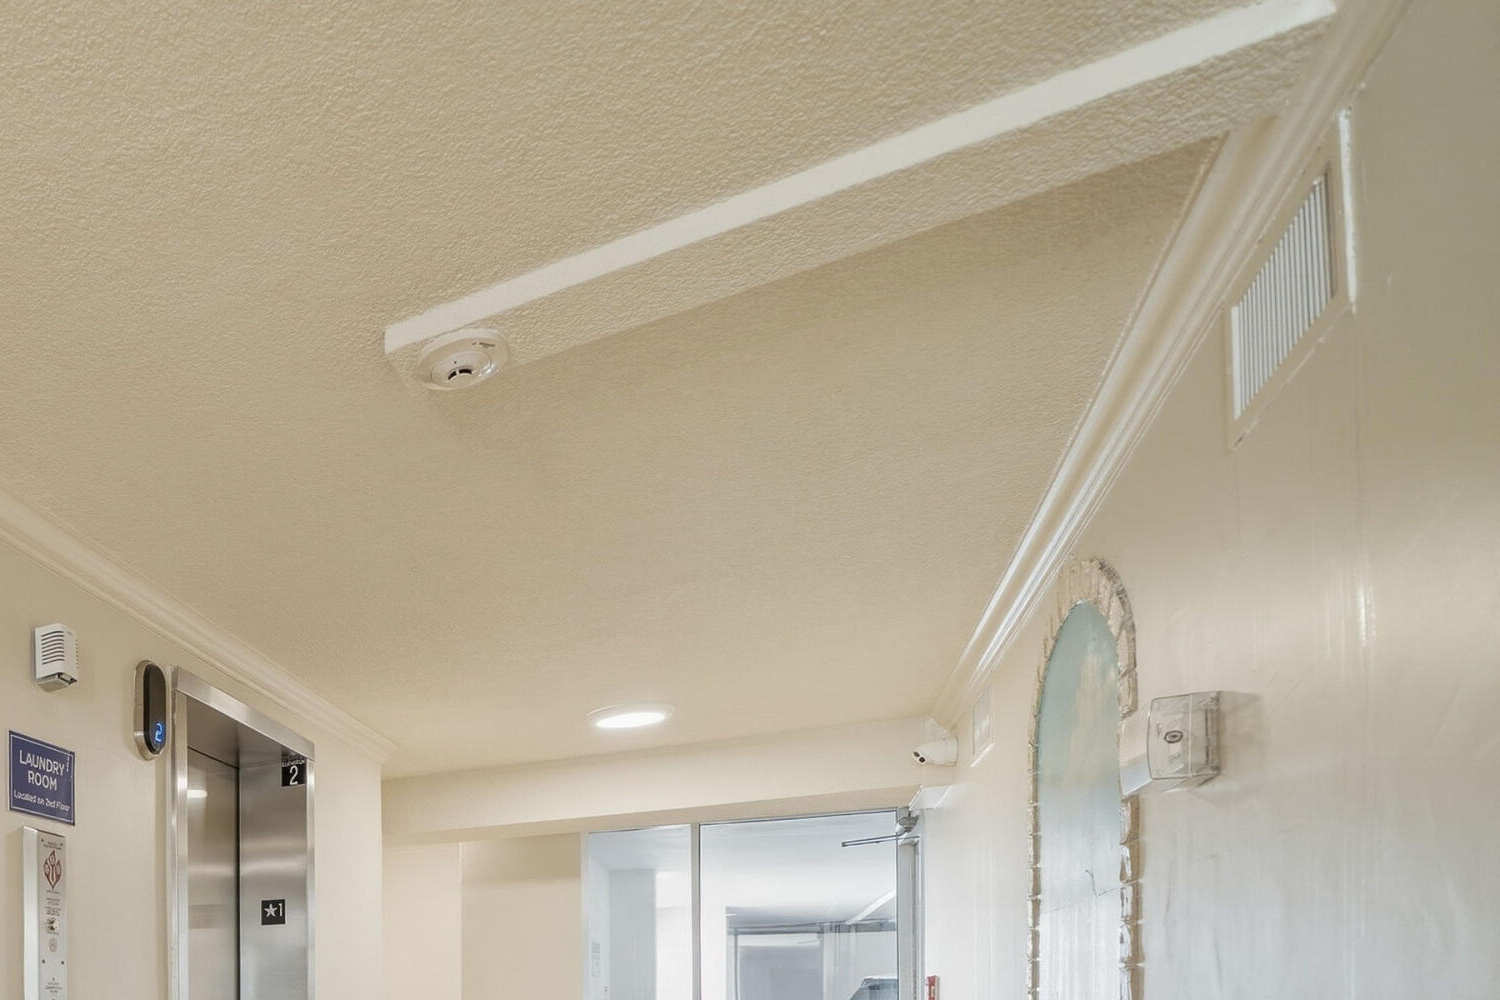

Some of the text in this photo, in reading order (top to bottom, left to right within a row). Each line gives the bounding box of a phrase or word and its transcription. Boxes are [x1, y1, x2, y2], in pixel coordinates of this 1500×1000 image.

[19, 749, 65, 776] LAUNDRY
[28, 770, 57, 791] ROOM
[289, 765, 298, 785] 2
[278, 903, 283, 917] 1
